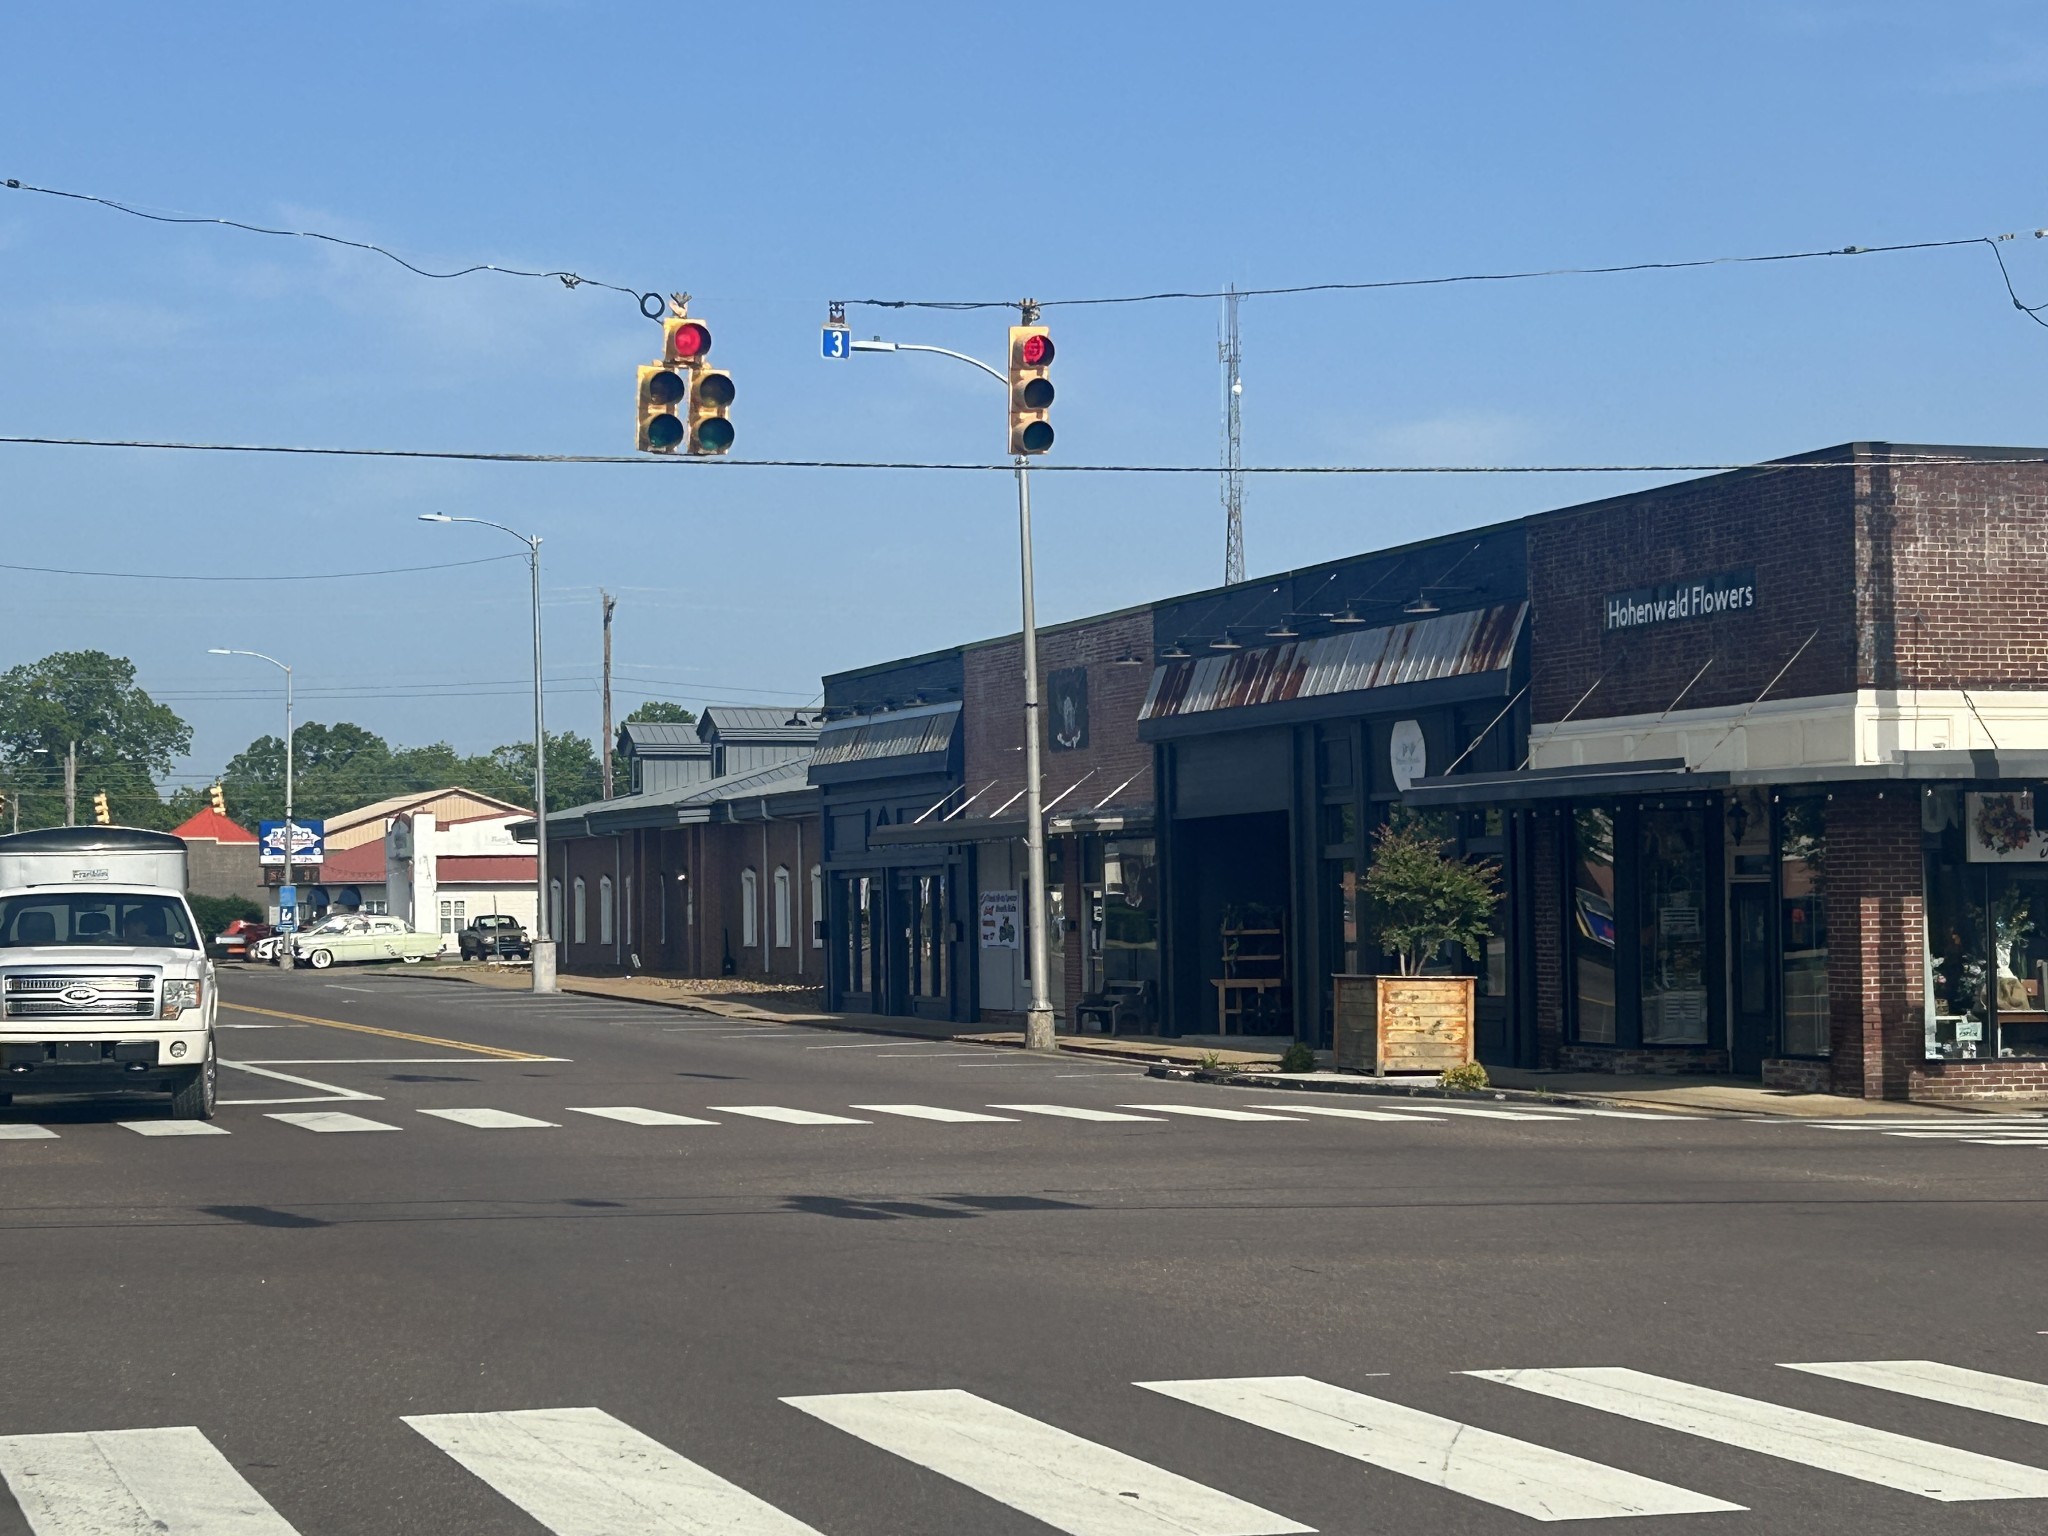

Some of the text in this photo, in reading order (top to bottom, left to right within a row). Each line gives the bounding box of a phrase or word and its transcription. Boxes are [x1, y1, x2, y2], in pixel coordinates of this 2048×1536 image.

[831, 331, 842, 357] 3
[1608, 585, 1753, 629] Hohenwald Flowers
